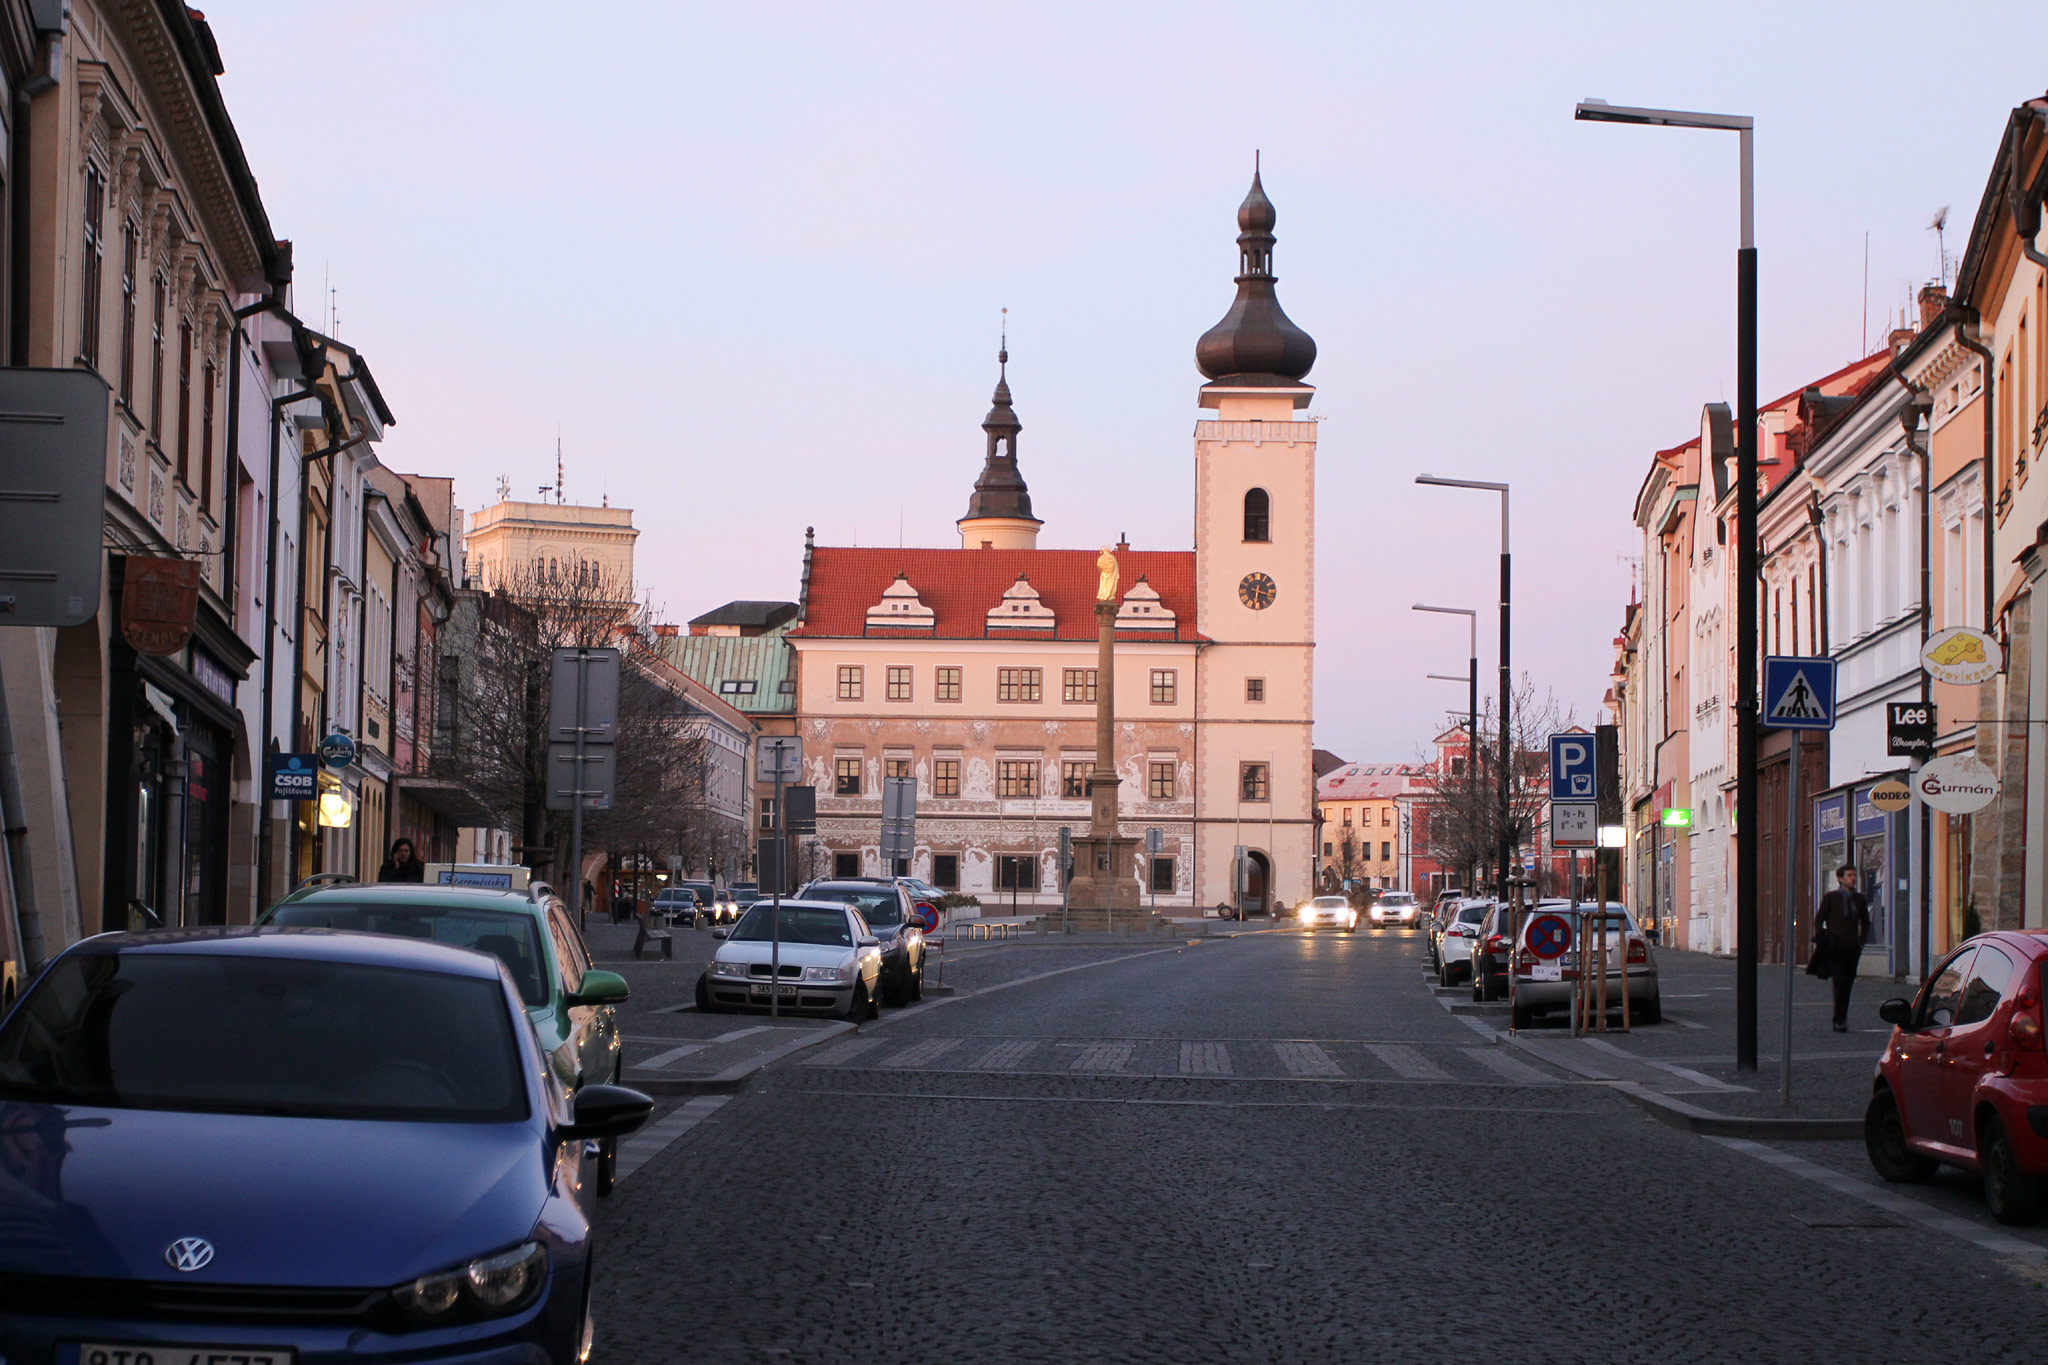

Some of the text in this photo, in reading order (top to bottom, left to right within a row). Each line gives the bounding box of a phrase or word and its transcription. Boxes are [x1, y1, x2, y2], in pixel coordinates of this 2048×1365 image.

[1894, 706, 1927, 724] Lee
[1892, 736, 1928, 749] Wrangler
[323, 746, 352, 757] Carlsberg
[1560, 743, 1586, 779] P
[275, 774, 313, 786] ČSOB
[1921, 778, 1993, 795] Gurmán
[274, 787, 312, 796] Pojišťovna
[1873, 791, 1910, 801] RODEO
[1948, 1118, 1963, 1138] 107
